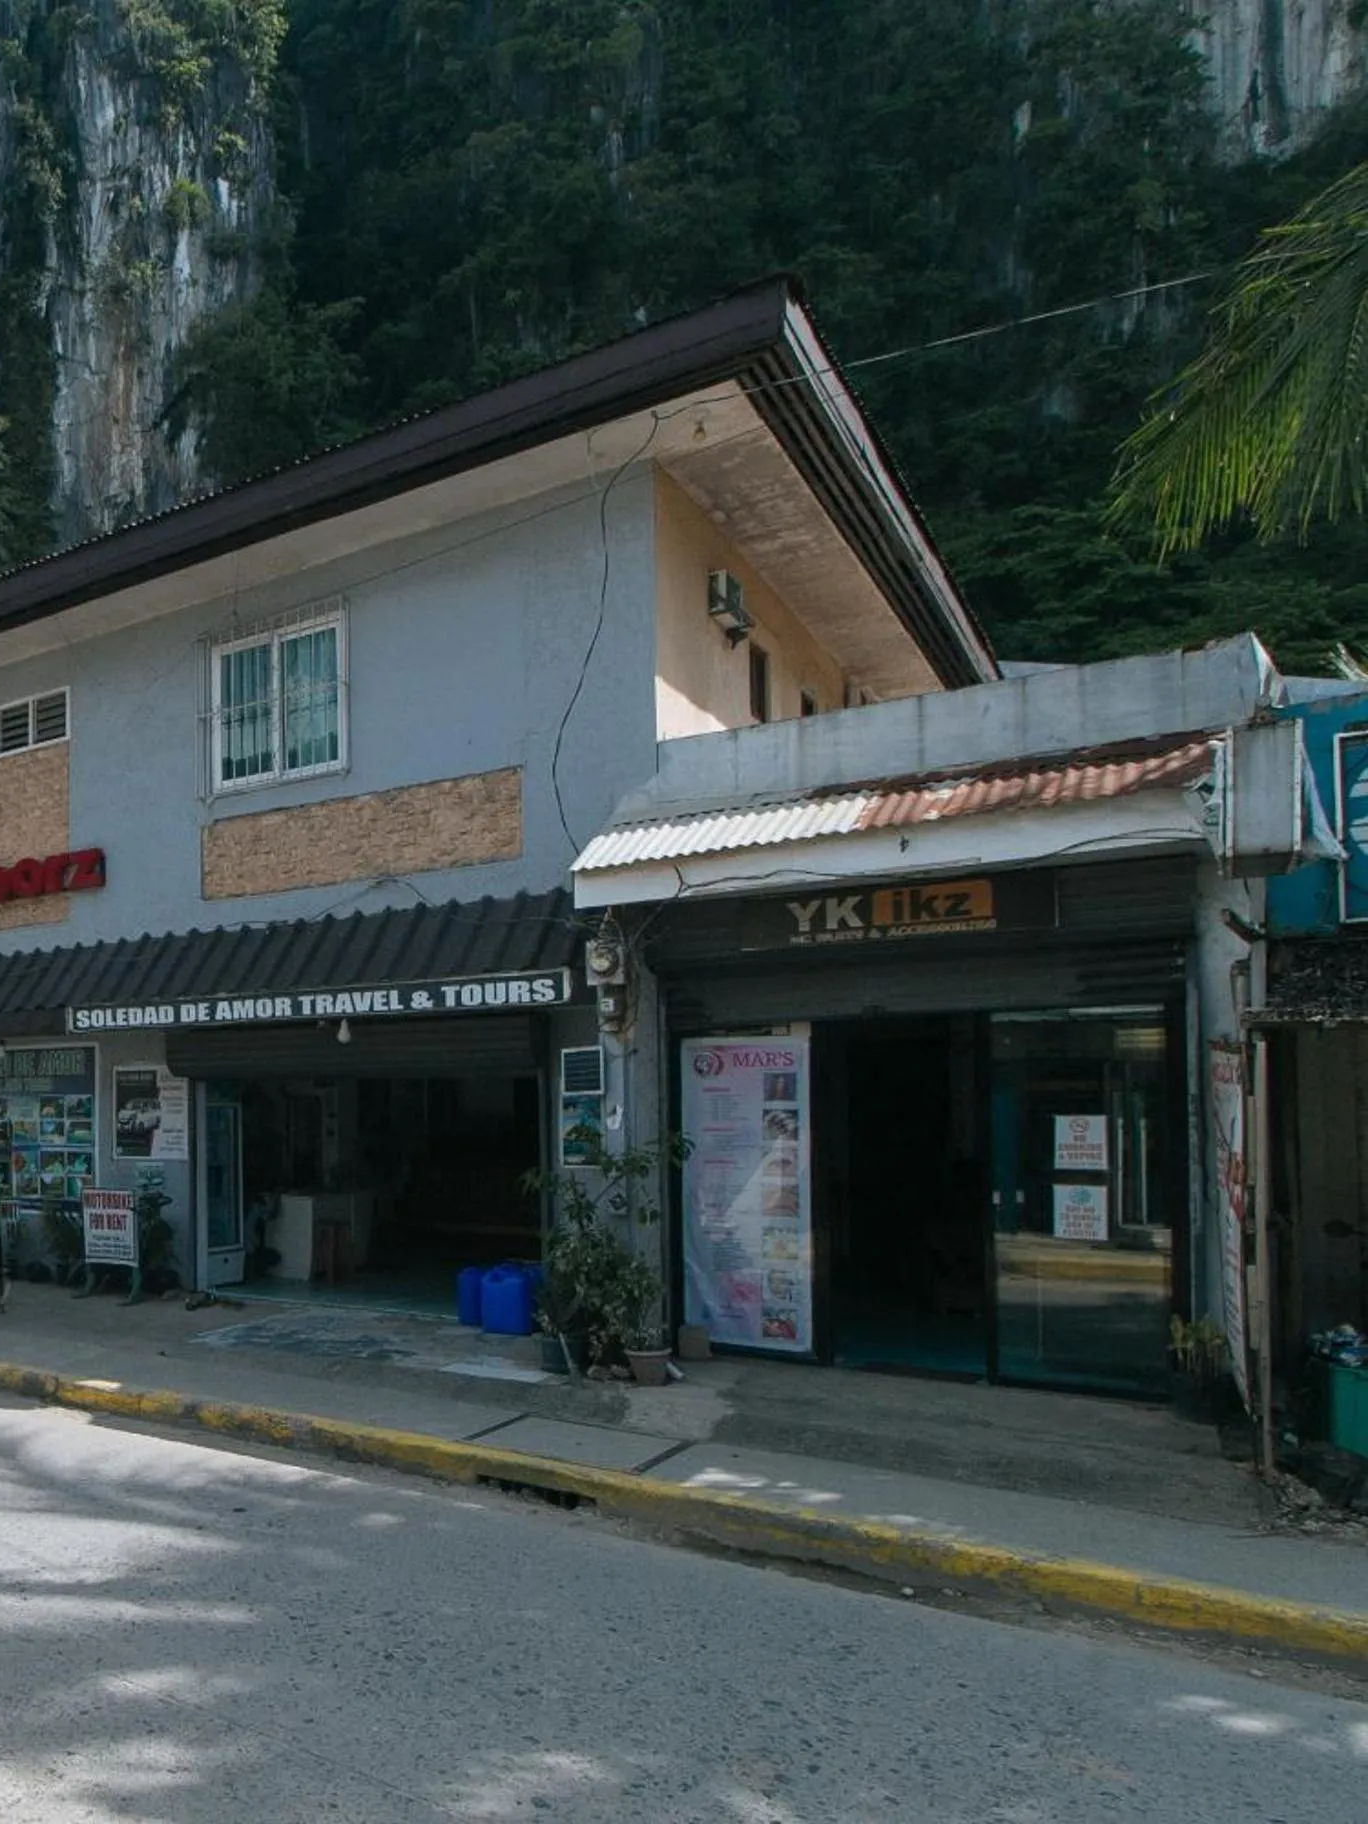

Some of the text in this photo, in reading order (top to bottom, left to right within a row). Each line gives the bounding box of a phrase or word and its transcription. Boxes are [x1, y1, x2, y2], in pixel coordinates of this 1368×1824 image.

[786, 889, 973, 932] YK ikz
[76, 979, 556, 1028] SOLEDAD DE AMOR TRAVEL & TOURS
[732, 1051, 794, 1067] MAR'S
